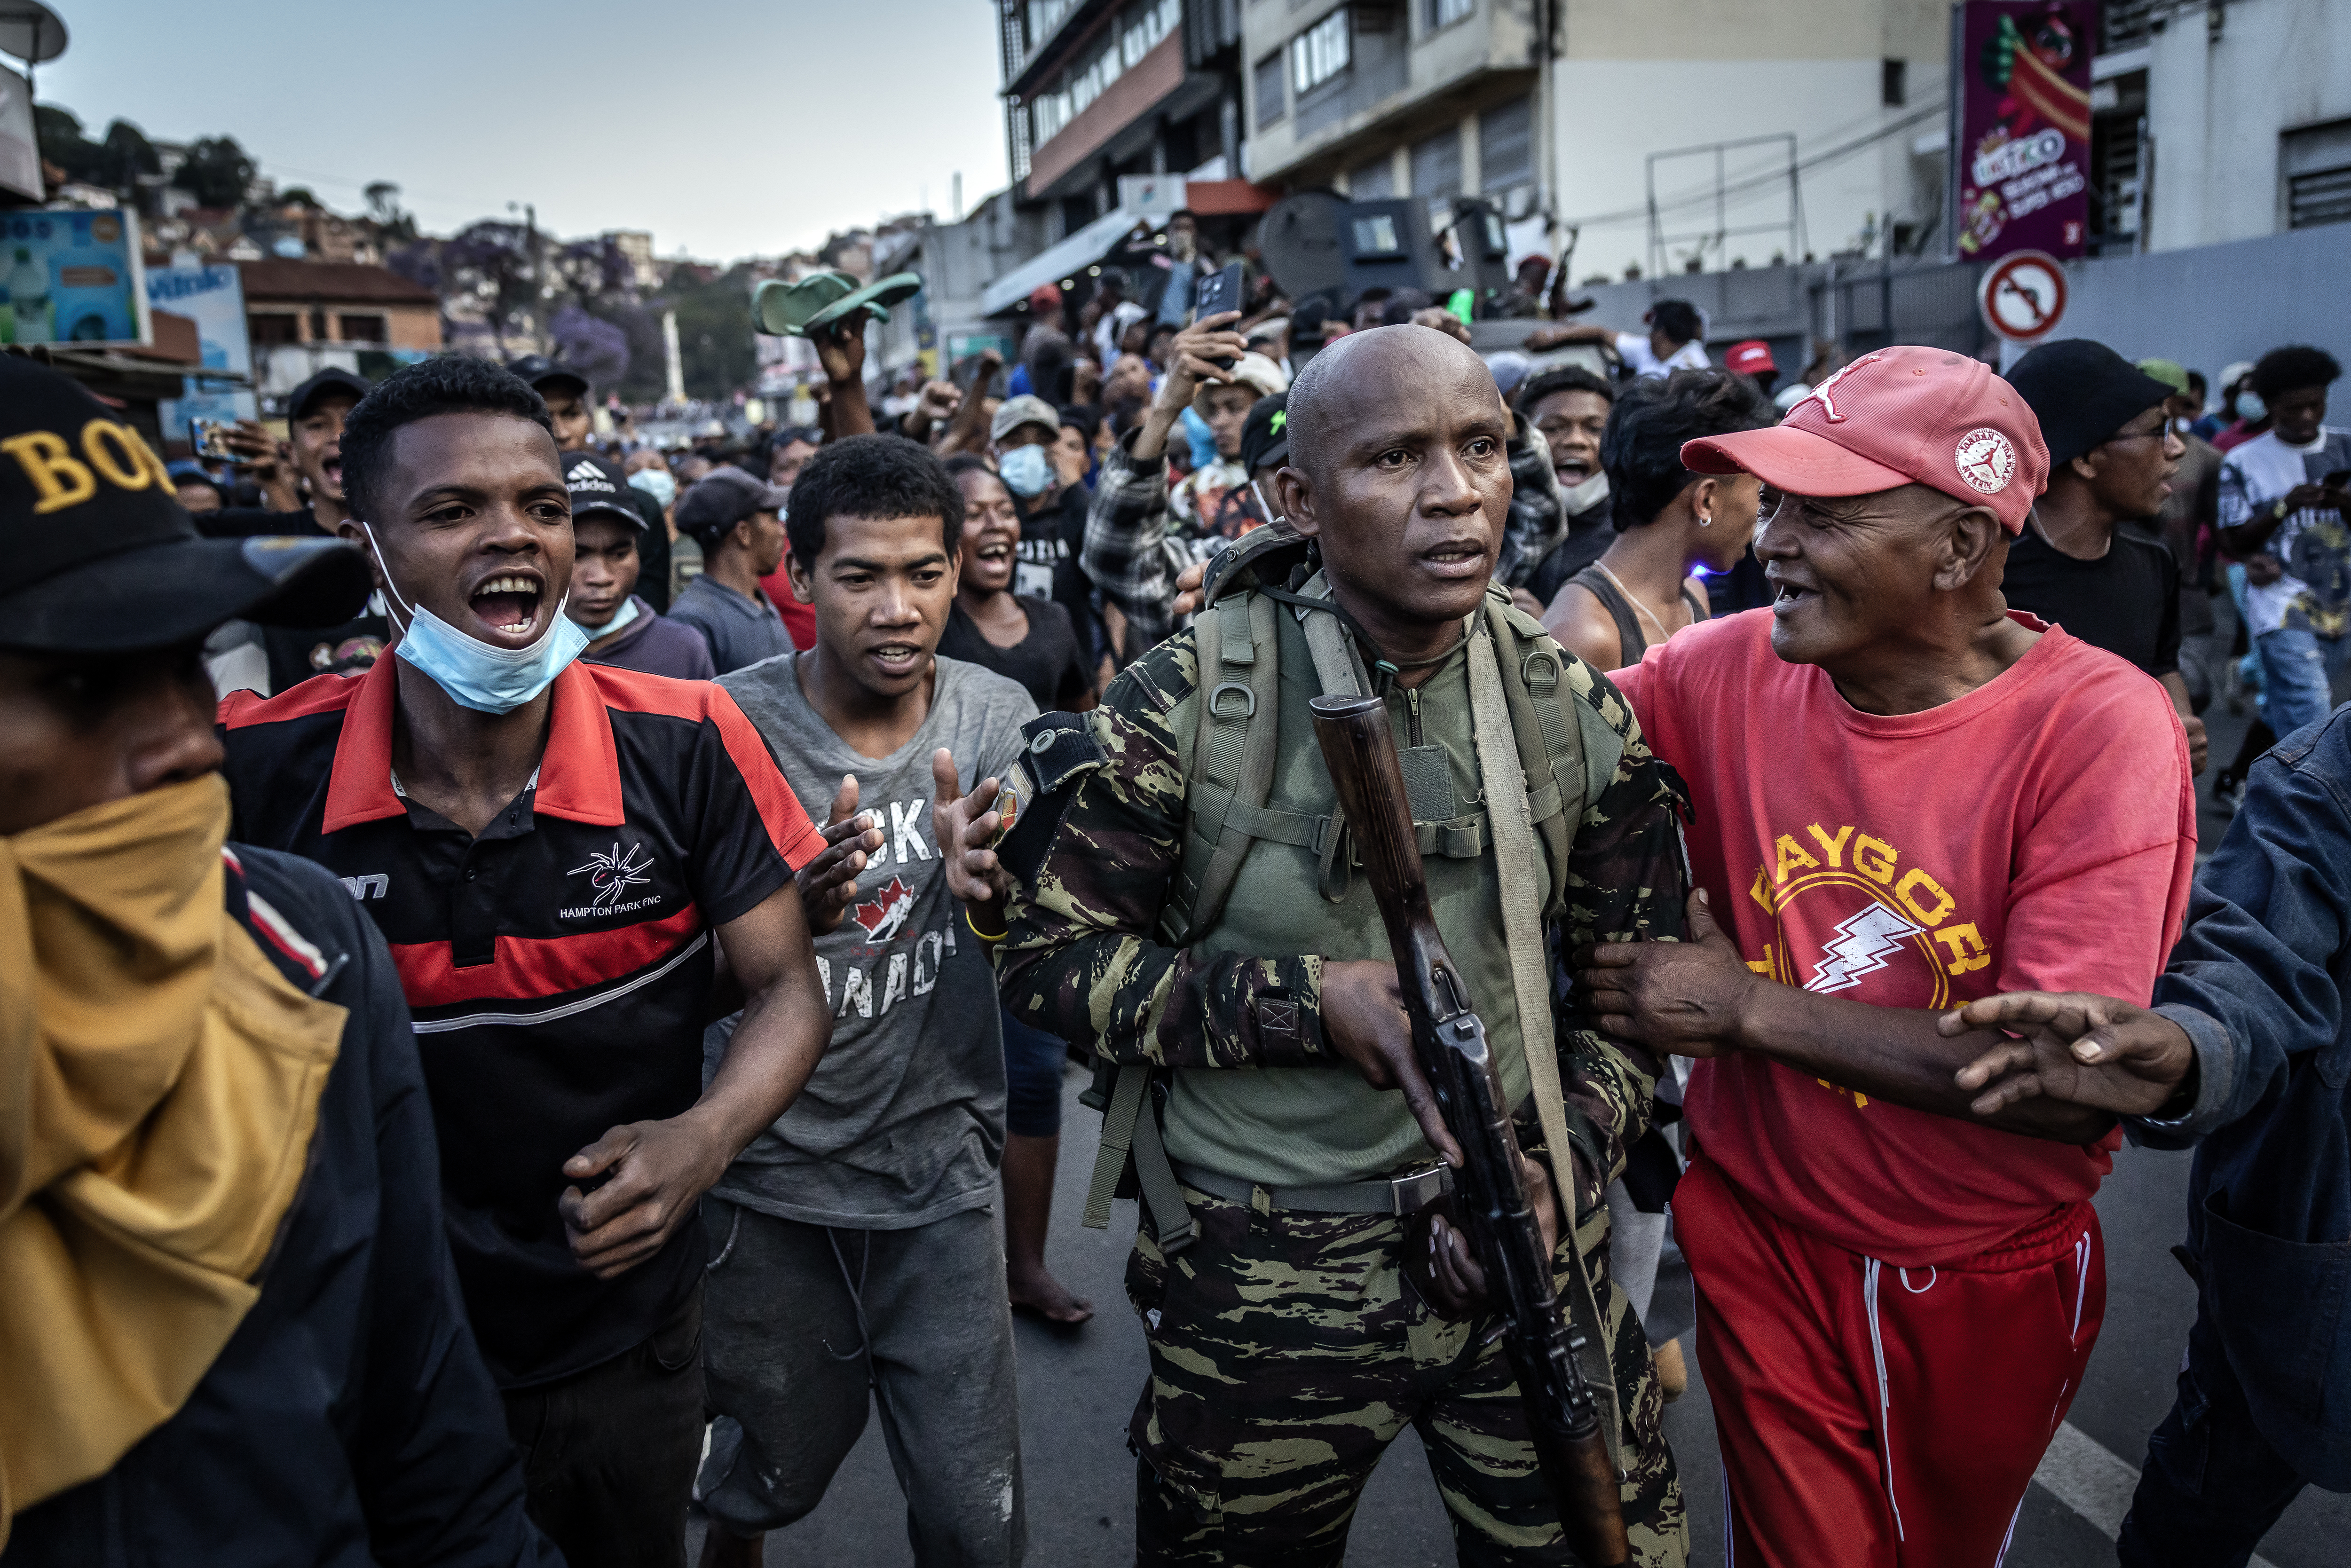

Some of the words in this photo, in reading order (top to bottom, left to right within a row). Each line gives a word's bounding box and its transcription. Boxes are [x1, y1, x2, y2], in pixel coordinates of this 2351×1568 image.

[566, 478, 616, 493] adidas
[560, 906, 612, 918] HAMPTON
[615, 900, 641, 914] PARK
[643, 895, 661, 907] FNC
